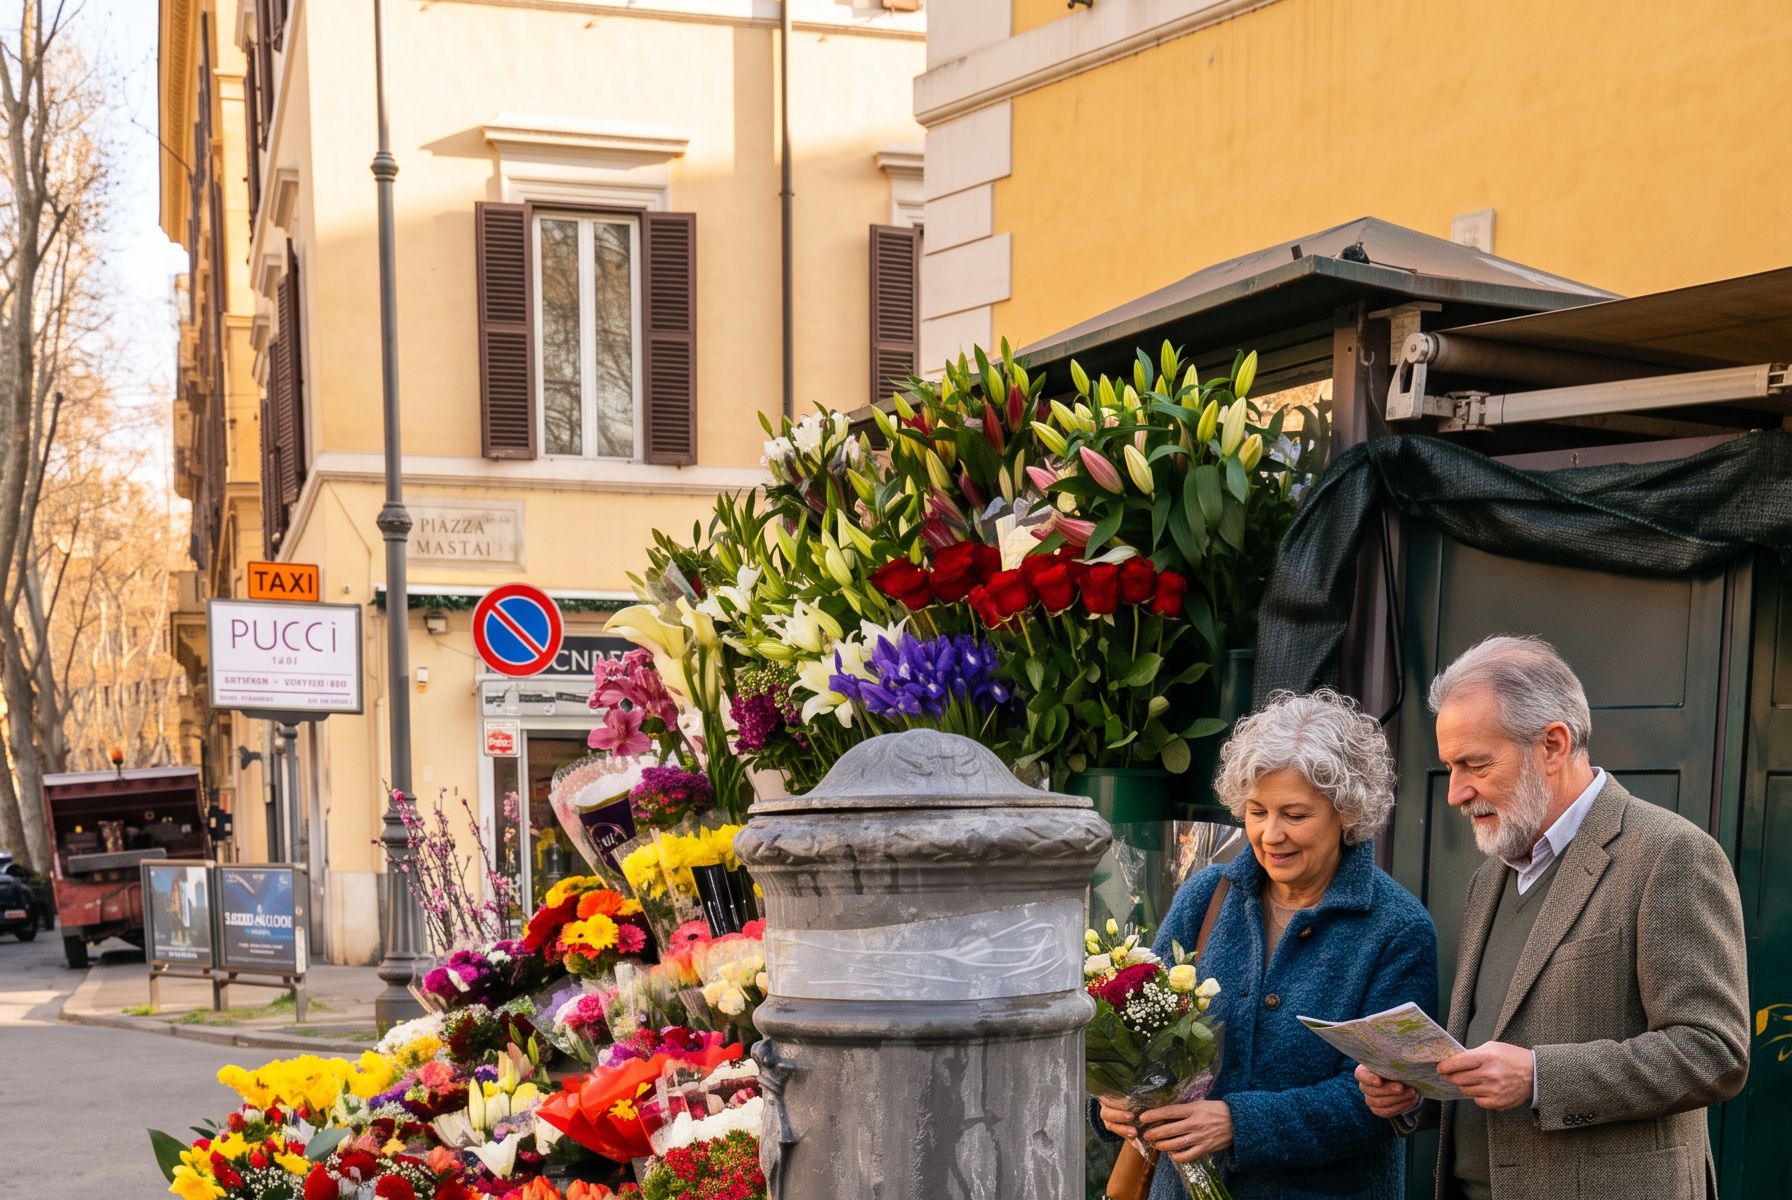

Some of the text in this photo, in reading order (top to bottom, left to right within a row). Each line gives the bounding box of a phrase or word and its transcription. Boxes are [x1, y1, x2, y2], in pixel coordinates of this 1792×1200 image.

[420, 518, 485, 535] PIAZZA
[416, 540, 491, 556] MASTAI
[254, 571, 313, 594] TAXI
